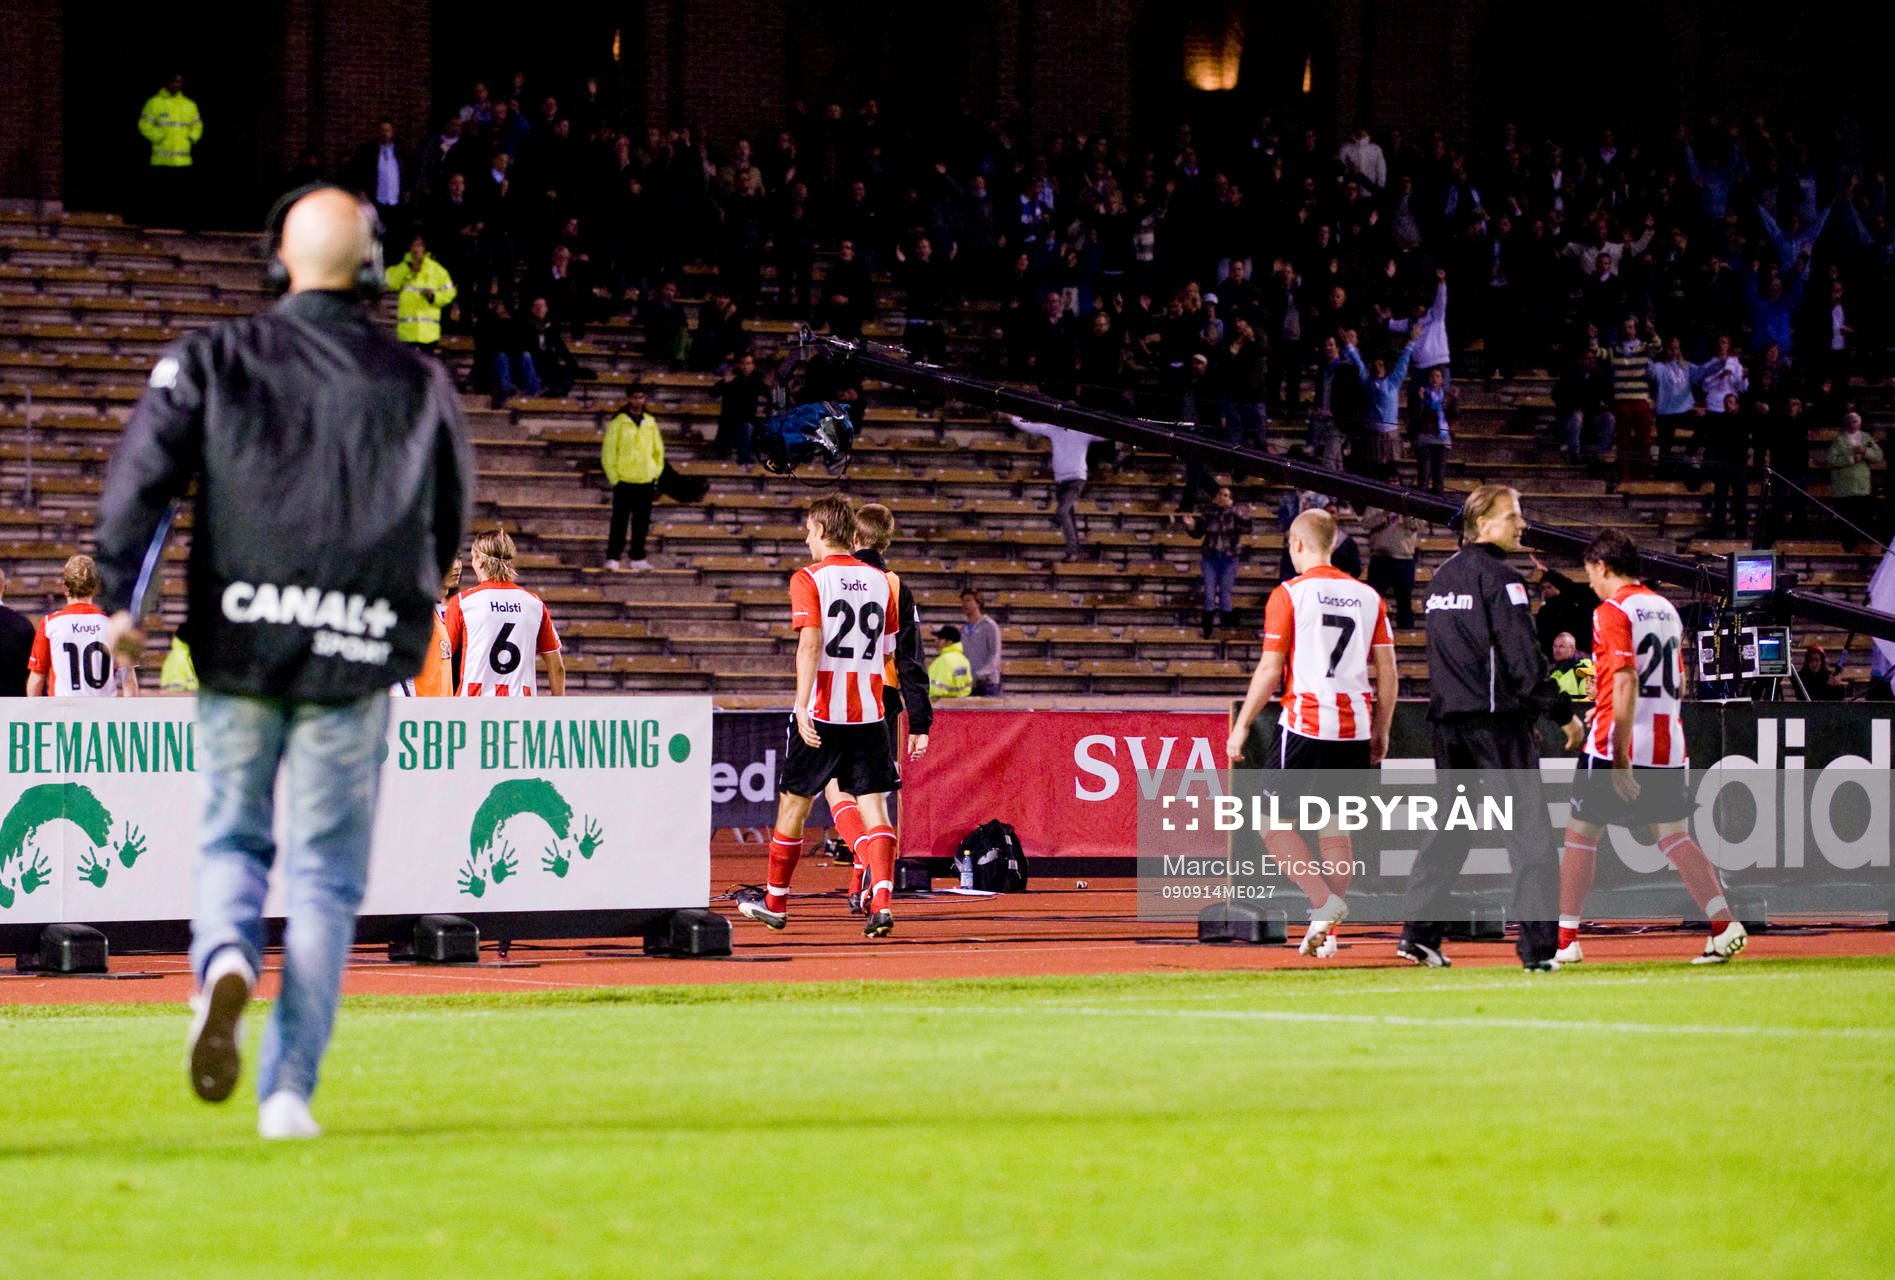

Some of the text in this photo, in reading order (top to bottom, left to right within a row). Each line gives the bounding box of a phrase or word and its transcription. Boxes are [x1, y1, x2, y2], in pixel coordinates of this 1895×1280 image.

[221, 580, 398, 638] CANAL+
[490, 601, 522, 613] Halsti
[1317, 591, 1362, 608] Larsson
[72, 623, 101, 635] Kruys
[489, 622, 521, 675] 6
[825, 599, 885, 660] 29
[1322, 613, 1356, 678] 7
[63, 641, 111, 690] 10
[1636, 632, 1681, 701] 20
[399, 719, 660, 770] SBP BEMANNING
[1073, 734, 1224, 801] SVA
